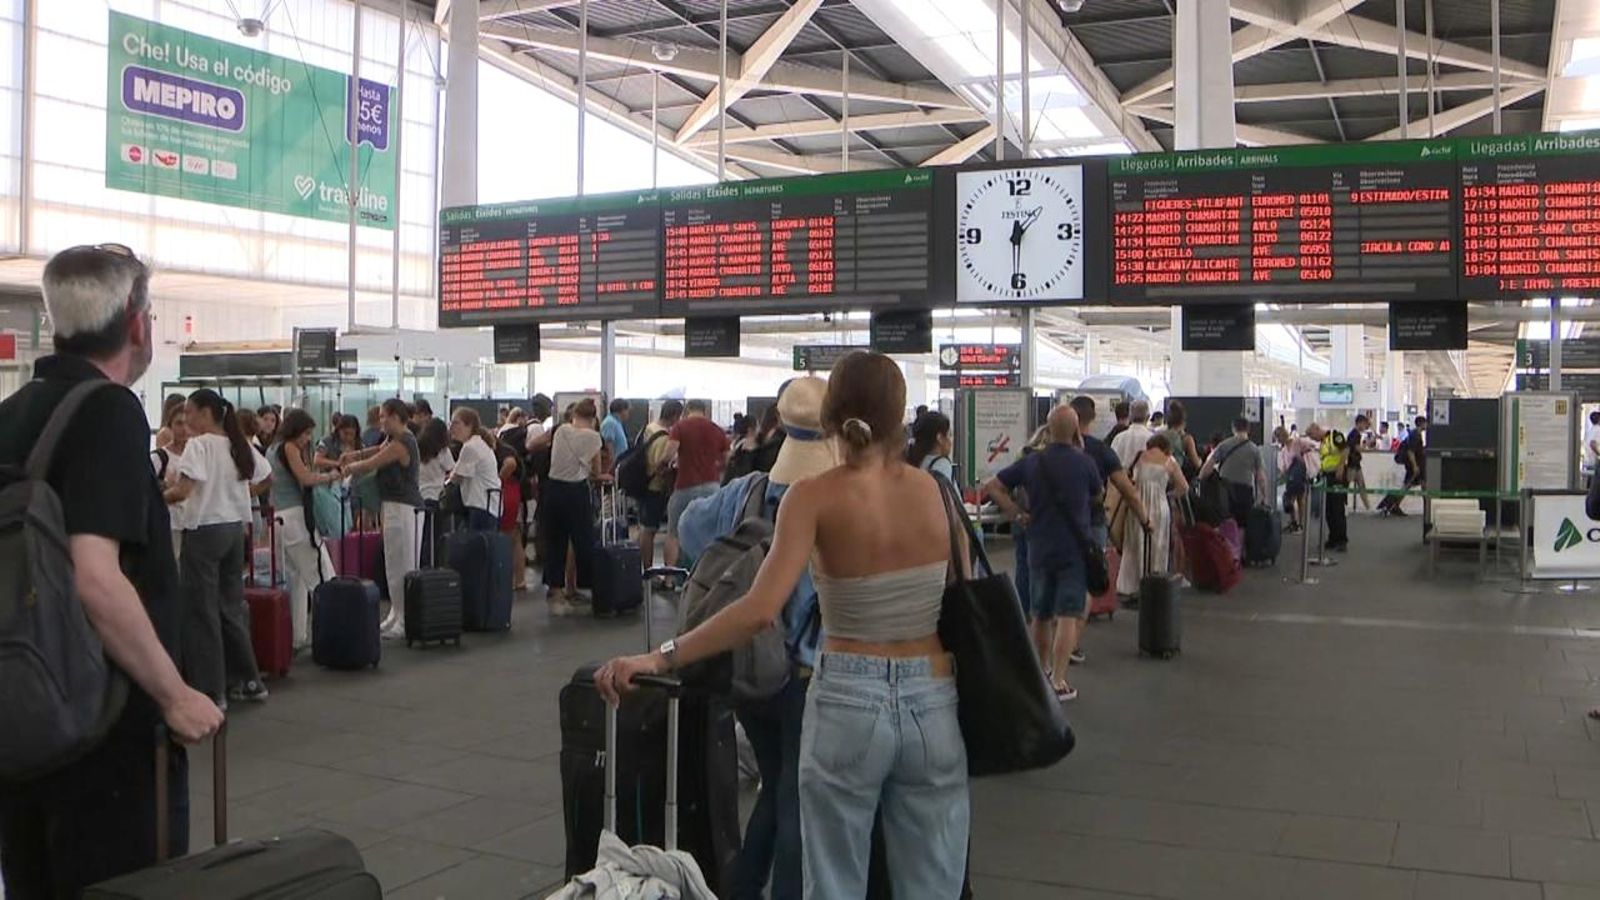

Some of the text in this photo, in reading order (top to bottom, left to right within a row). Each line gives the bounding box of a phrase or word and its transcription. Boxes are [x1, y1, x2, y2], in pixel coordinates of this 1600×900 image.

[123, 33, 292, 95] Che! Usa el código
[133, 76, 237, 120] MEPIRO
[1470, 136, 1600, 156] Llegadas Arribades
[1121, 154, 1278, 171] Llegadas Arribades ARRIVALS
[670, 190, 701, 201] Salidas
[706, 187, 738, 198] Eixides
[1006, 179, 1031, 196] 12
[1464, 187, 1496, 197] 16:34
[1498, 185, 1539, 196] MADRID
[1145, 196, 1244, 210] FIGUERES-VILAFANT
[1252, 195, 1295, 206] EUROMED
[1299, 194, 1329, 204] 01101
[1350, 193, 1359, 202] 9
[1464, 200, 1497, 211] 17:19
[1499, 198, 1539, 209] MADRID
[1115, 214, 1144, 224] 14:22
[1145, 211, 1180, 222] MADRID
[1253, 208, 1294, 219] INTERCI
[1464, 212, 1497, 224] 18:19
[1499, 211, 1539, 223] MADRID
[1057, 223, 1073, 241] 3
[1115, 224, 1144, 235] 14:29
[1145, 224, 1180, 235] MADRID
[1253, 220, 1277, 231] AVLO
[1464, 226, 1497, 237] 18:32
[966, 228, 982, 244] 9
[1145, 236, 1180, 246] MADRID
[1253, 233, 1278, 243] IRYO
[1464, 239, 1497, 250] 18:40
[1500, 238, 1539, 249] MADRID
[1115, 249, 1144, 260] 15:00
[1253, 246, 1271, 256] AVE
[1465, 252, 1497, 262] 18:57
[1500, 250, 1559, 261] BARCELONA
[1115, 261, 1144, 271] 15:30
[1145, 259, 1239, 270] ALACANT/ALICANTE
[1253, 258, 1296, 268] EUROMED
[1465, 265, 1497, 276] 19:04
[1500, 264, 1539, 275] MADRID
[1011, 272, 1027, 290] 6
[1115, 274, 1144, 284] 16:25
[1145, 272, 1180, 283] MADRID
[1253, 270, 1271, 280] AVE
[1300, 269, 1332, 279] 05140
[799, 358, 806, 368] 5
[1525, 352, 1533, 366] 3
